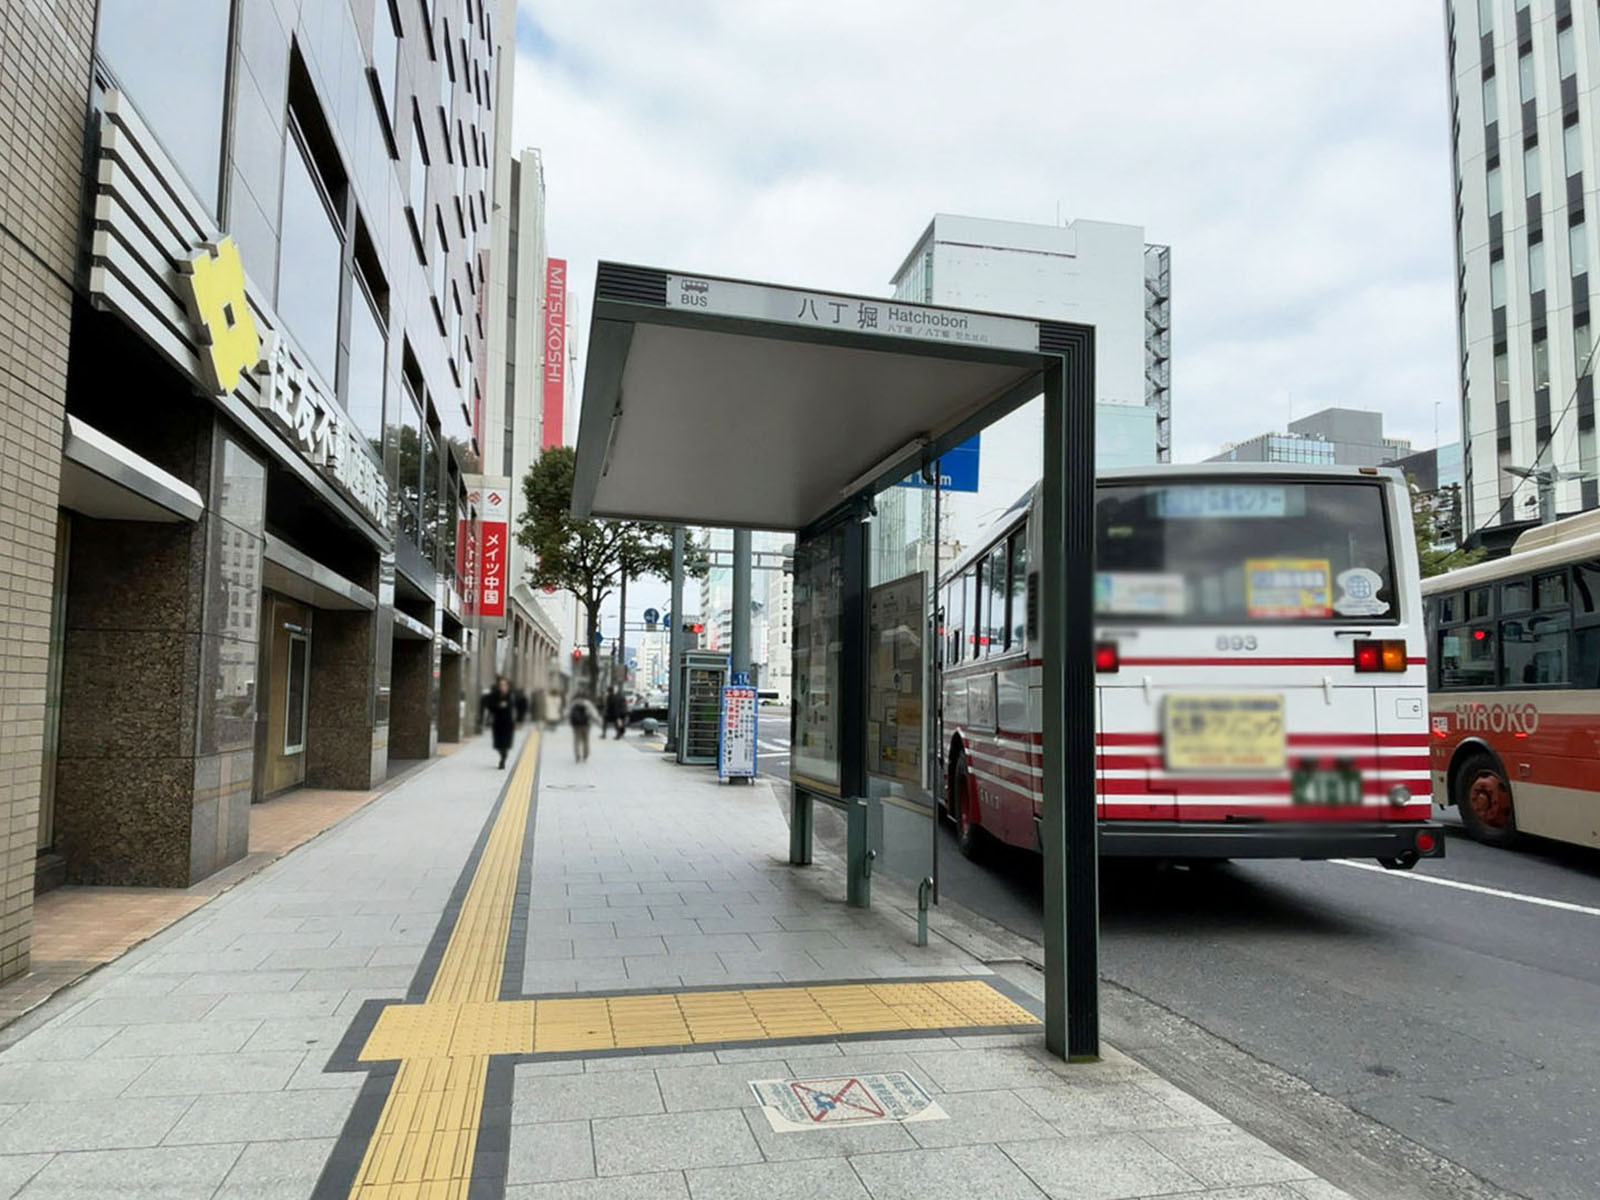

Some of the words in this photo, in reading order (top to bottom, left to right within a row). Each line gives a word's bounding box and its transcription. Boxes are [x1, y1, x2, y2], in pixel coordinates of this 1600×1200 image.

[681, 294, 708, 307] BUS
[798, 298, 878, 329] 八丁堀
[548, 266, 564, 383] MITSUKOSHI
[888, 307, 968, 329] Hatchobori
[484, 534, 500, 605] メイツ中国
[1215, 635, 1258, 651] 893
[1456, 703, 1539, 734] HIROKO
